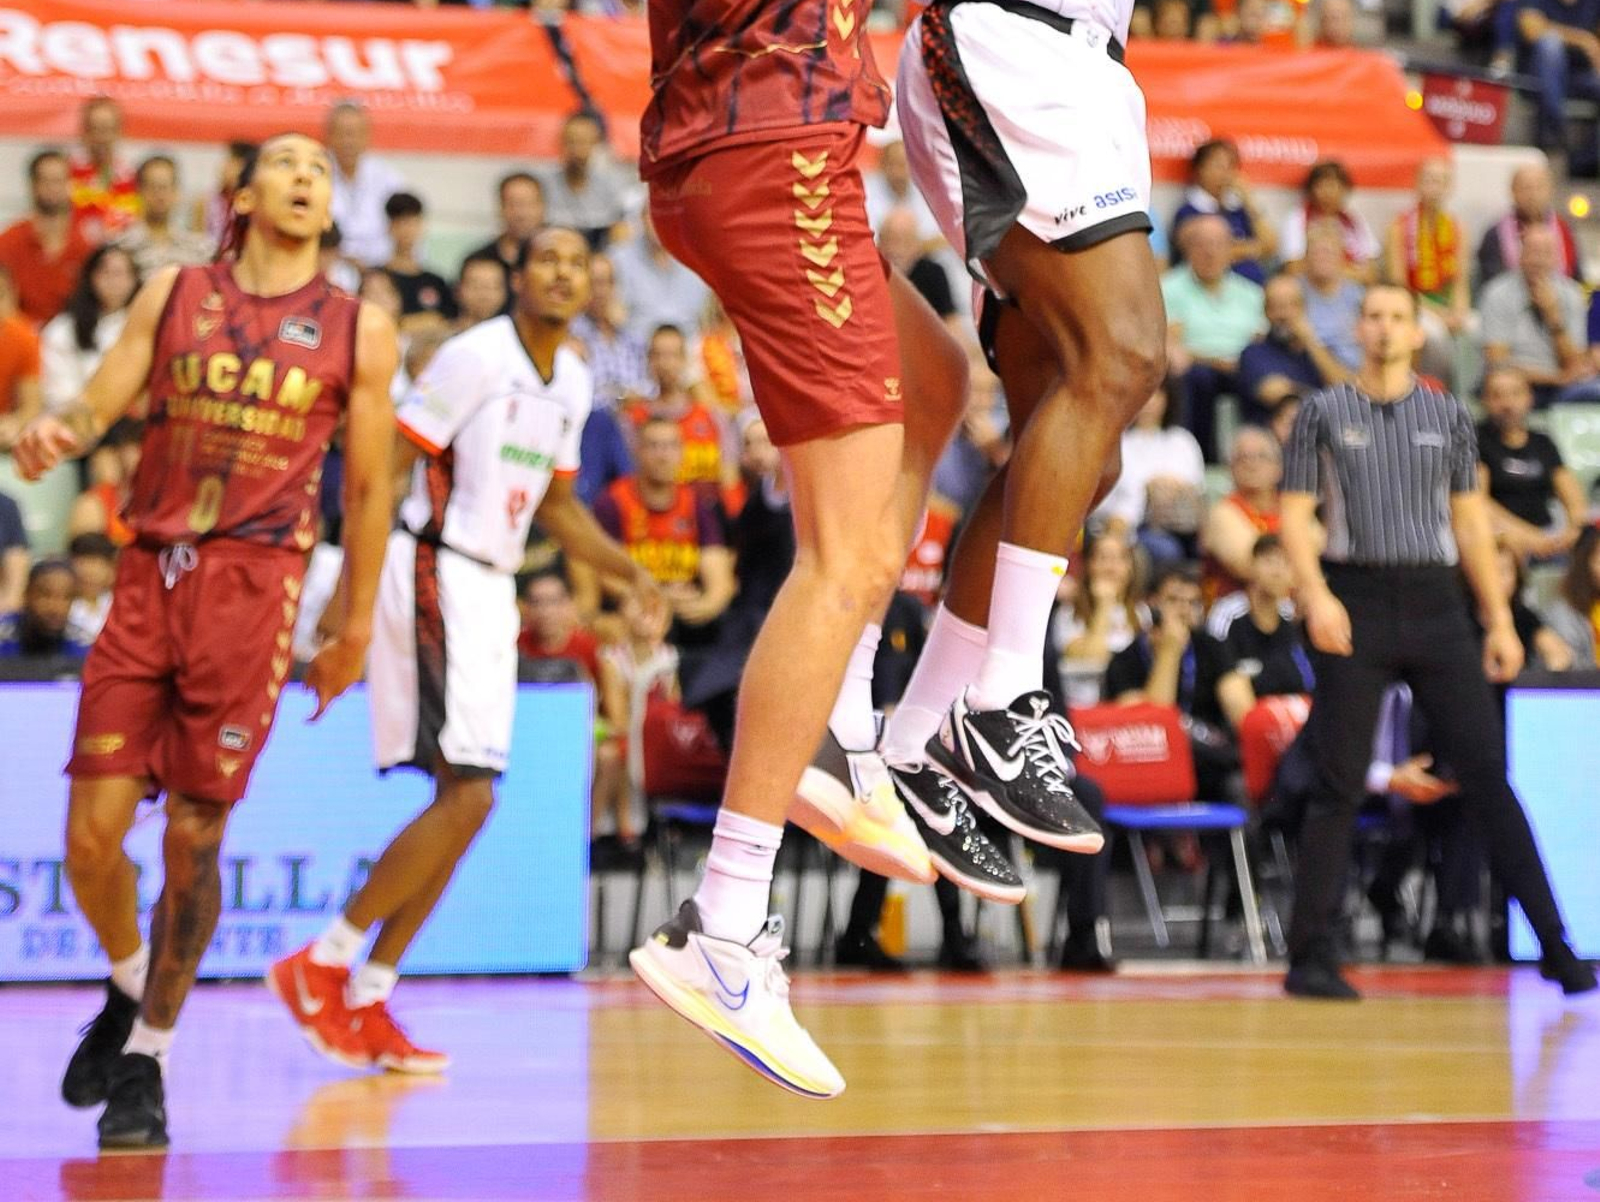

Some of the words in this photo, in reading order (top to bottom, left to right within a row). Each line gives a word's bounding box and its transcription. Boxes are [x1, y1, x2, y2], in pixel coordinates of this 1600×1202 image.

[0, 7, 454, 92] Renesur
[1054, 205, 1087, 226] vive
[170, 351, 324, 416] UCAM
